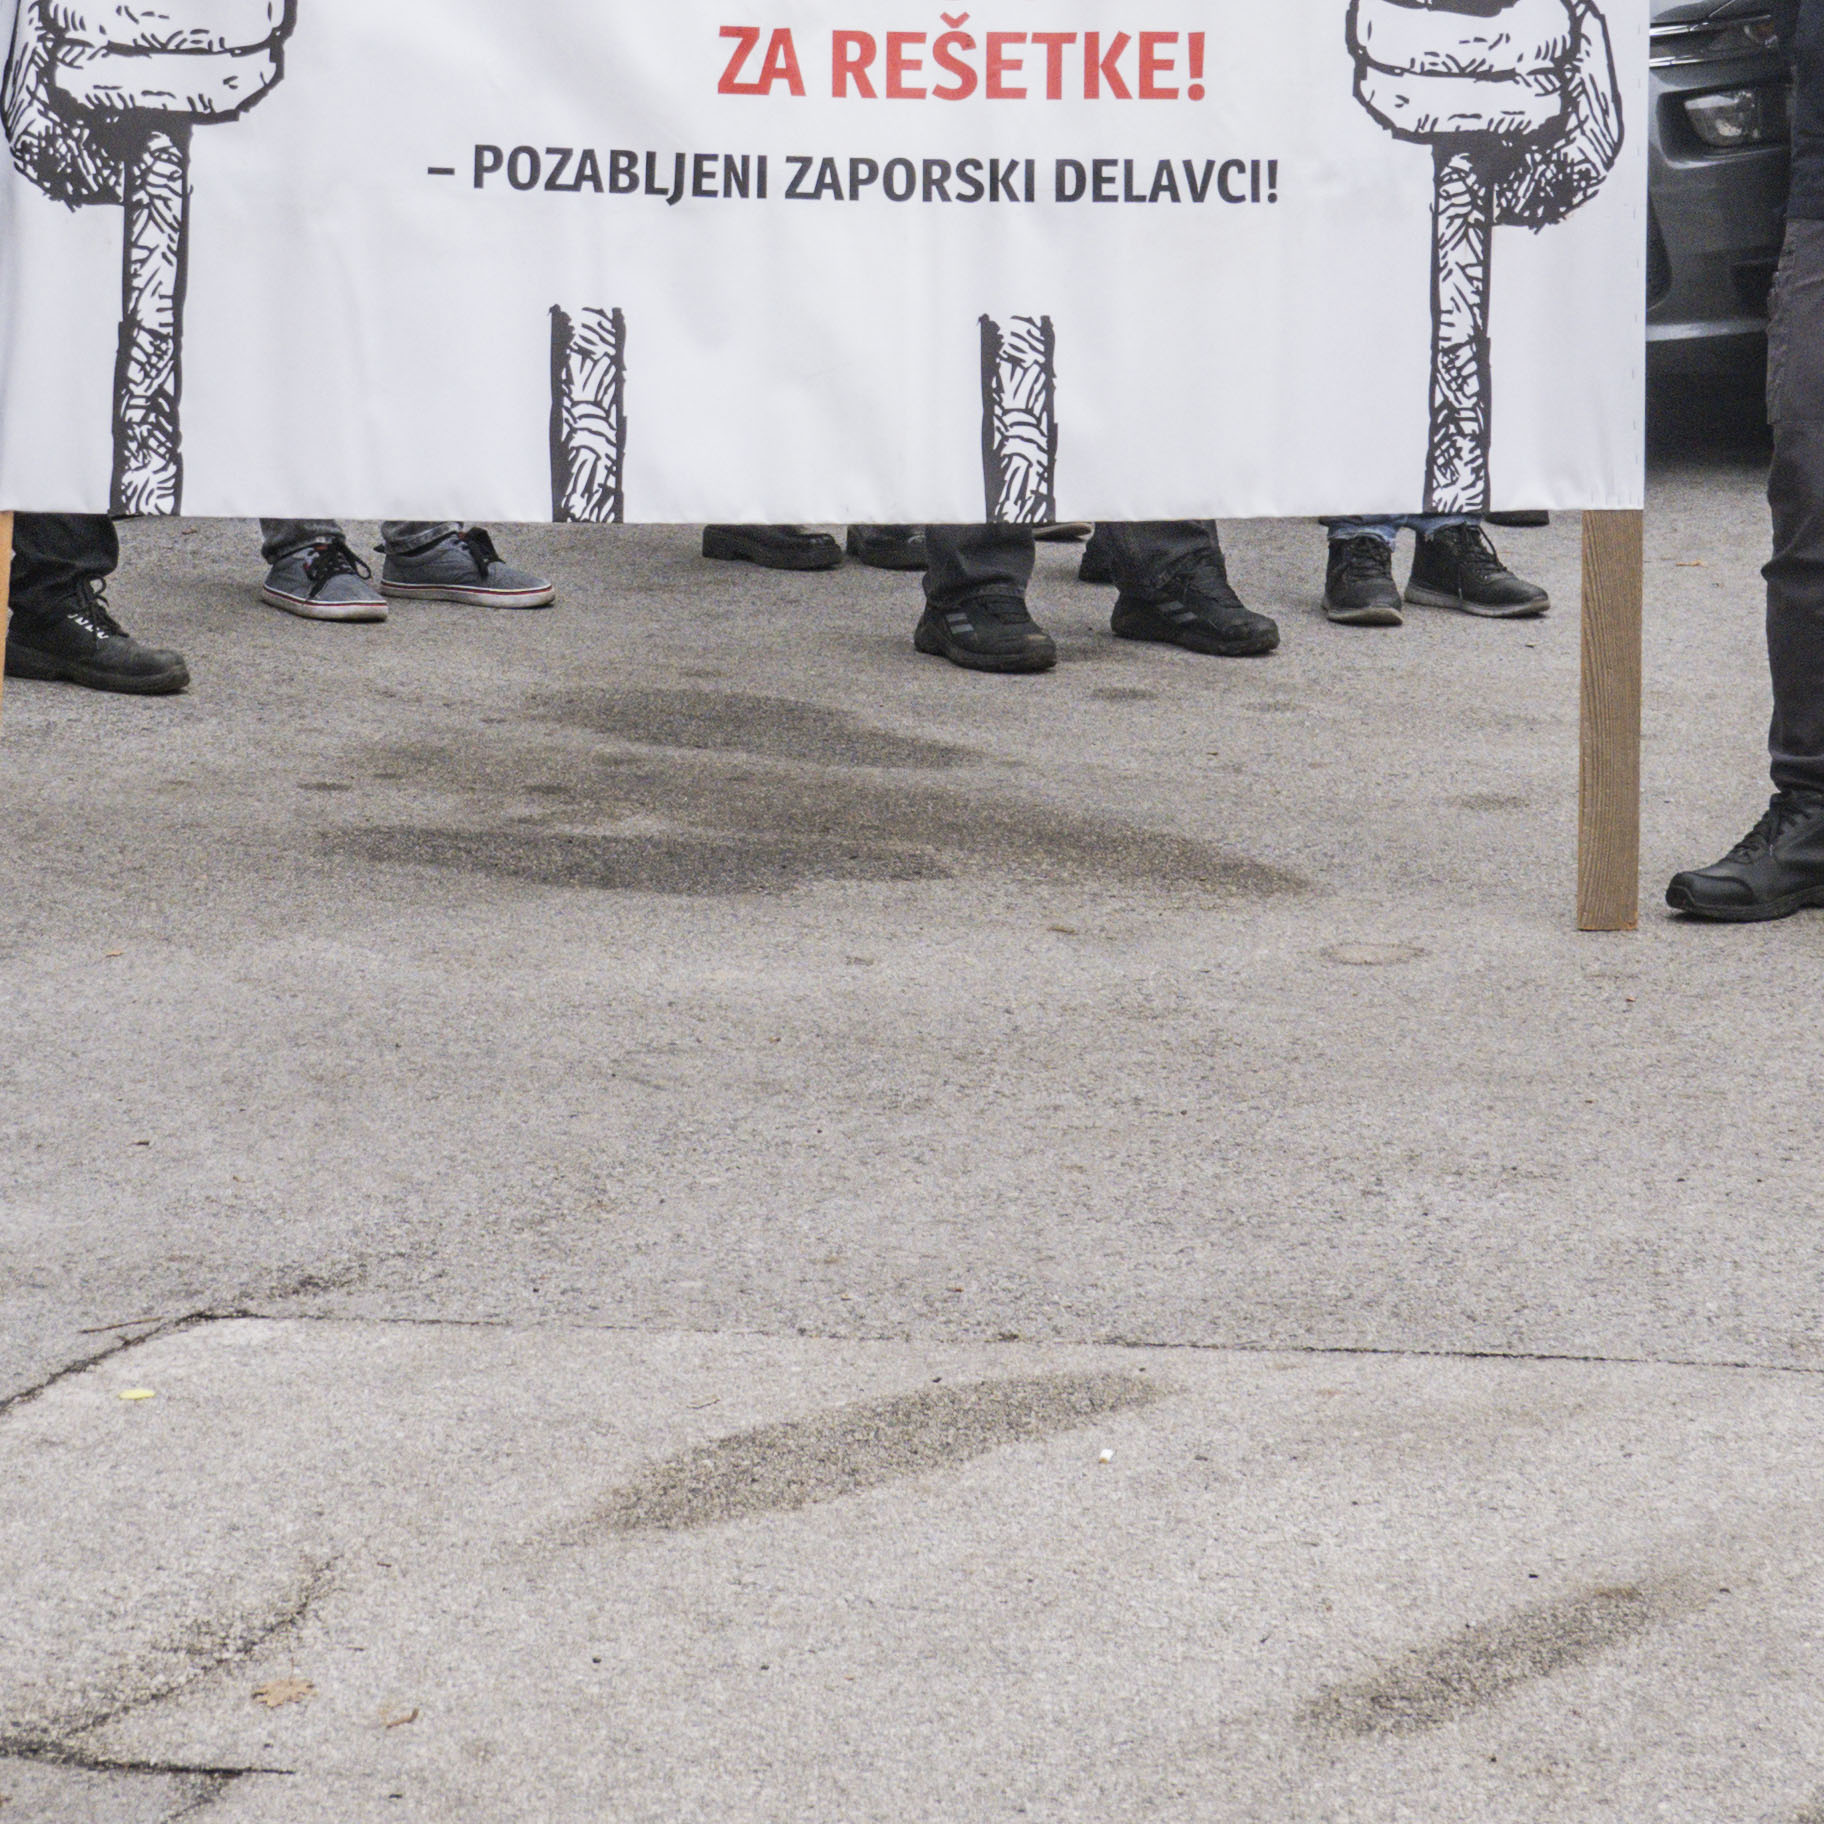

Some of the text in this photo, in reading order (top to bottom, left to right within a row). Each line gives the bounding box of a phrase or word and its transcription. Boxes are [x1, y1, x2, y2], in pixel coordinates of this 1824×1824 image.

[717, 13, 1205, 101] ZA REŠETKE!
[473, 144, 767, 206] POZABLJENI
[784, 156, 1035, 203] ZAPORSKI
[1055, 158, 1278, 204] DELAVCI!
